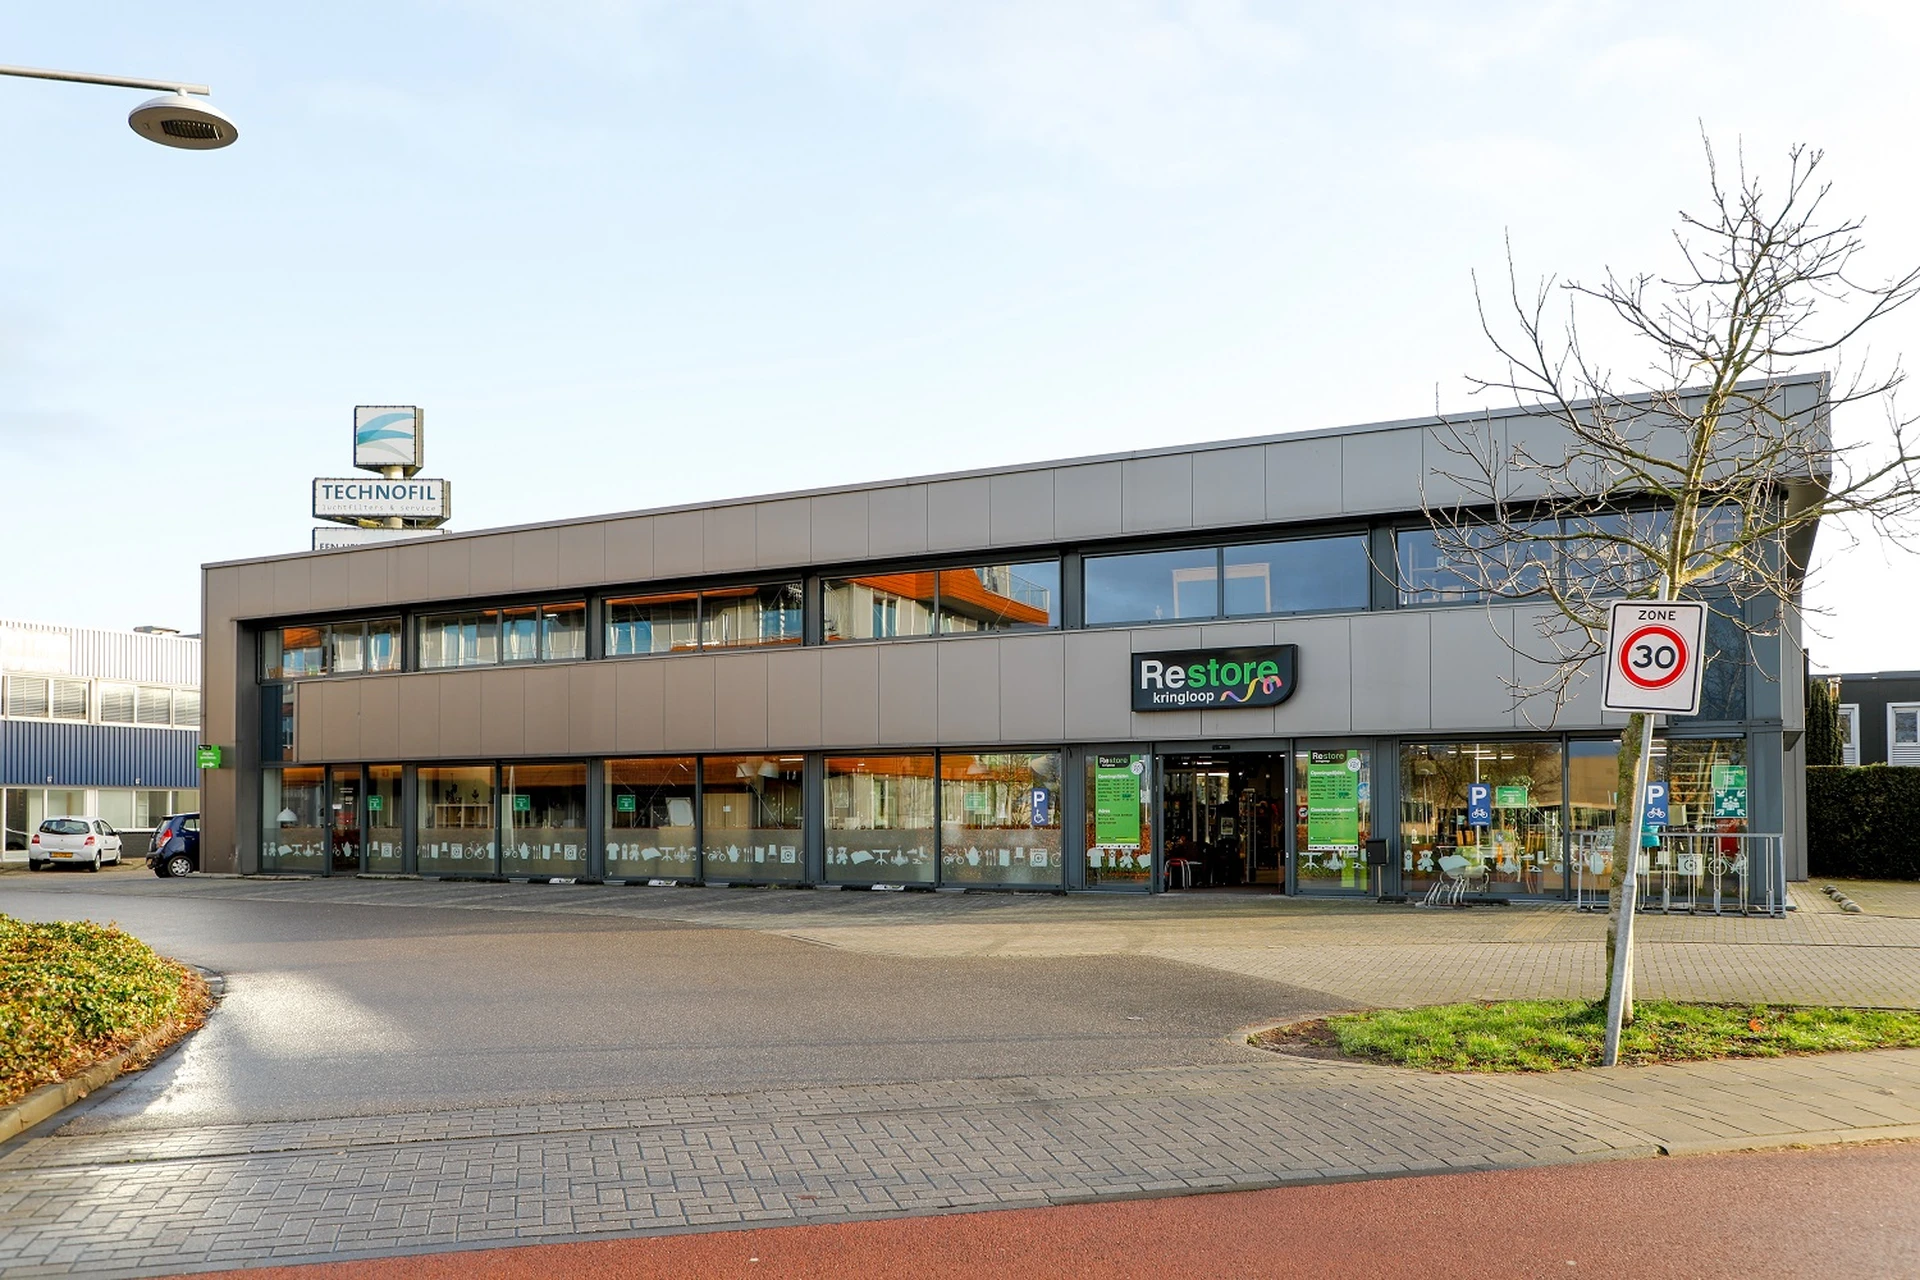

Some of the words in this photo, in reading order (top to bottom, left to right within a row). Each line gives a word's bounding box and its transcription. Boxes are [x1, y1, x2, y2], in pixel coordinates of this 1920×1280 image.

[322, 484, 436, 500] TECHNOFIL
[321, 503, 384, 511] luchtfilters
[1638, 610, 1676, 620] ZONE
[1632, 645, 1676, 669] 30
[1141, 659, 1279, 690] Restore
[1153, 691, 1215, 705] kringloop
[1312, 752, 1345, 760] Restore
[1033, 791, 1045, 807] P
[1471, 787, 1487, 806] P
[1647, 785, 1664, 804] P
